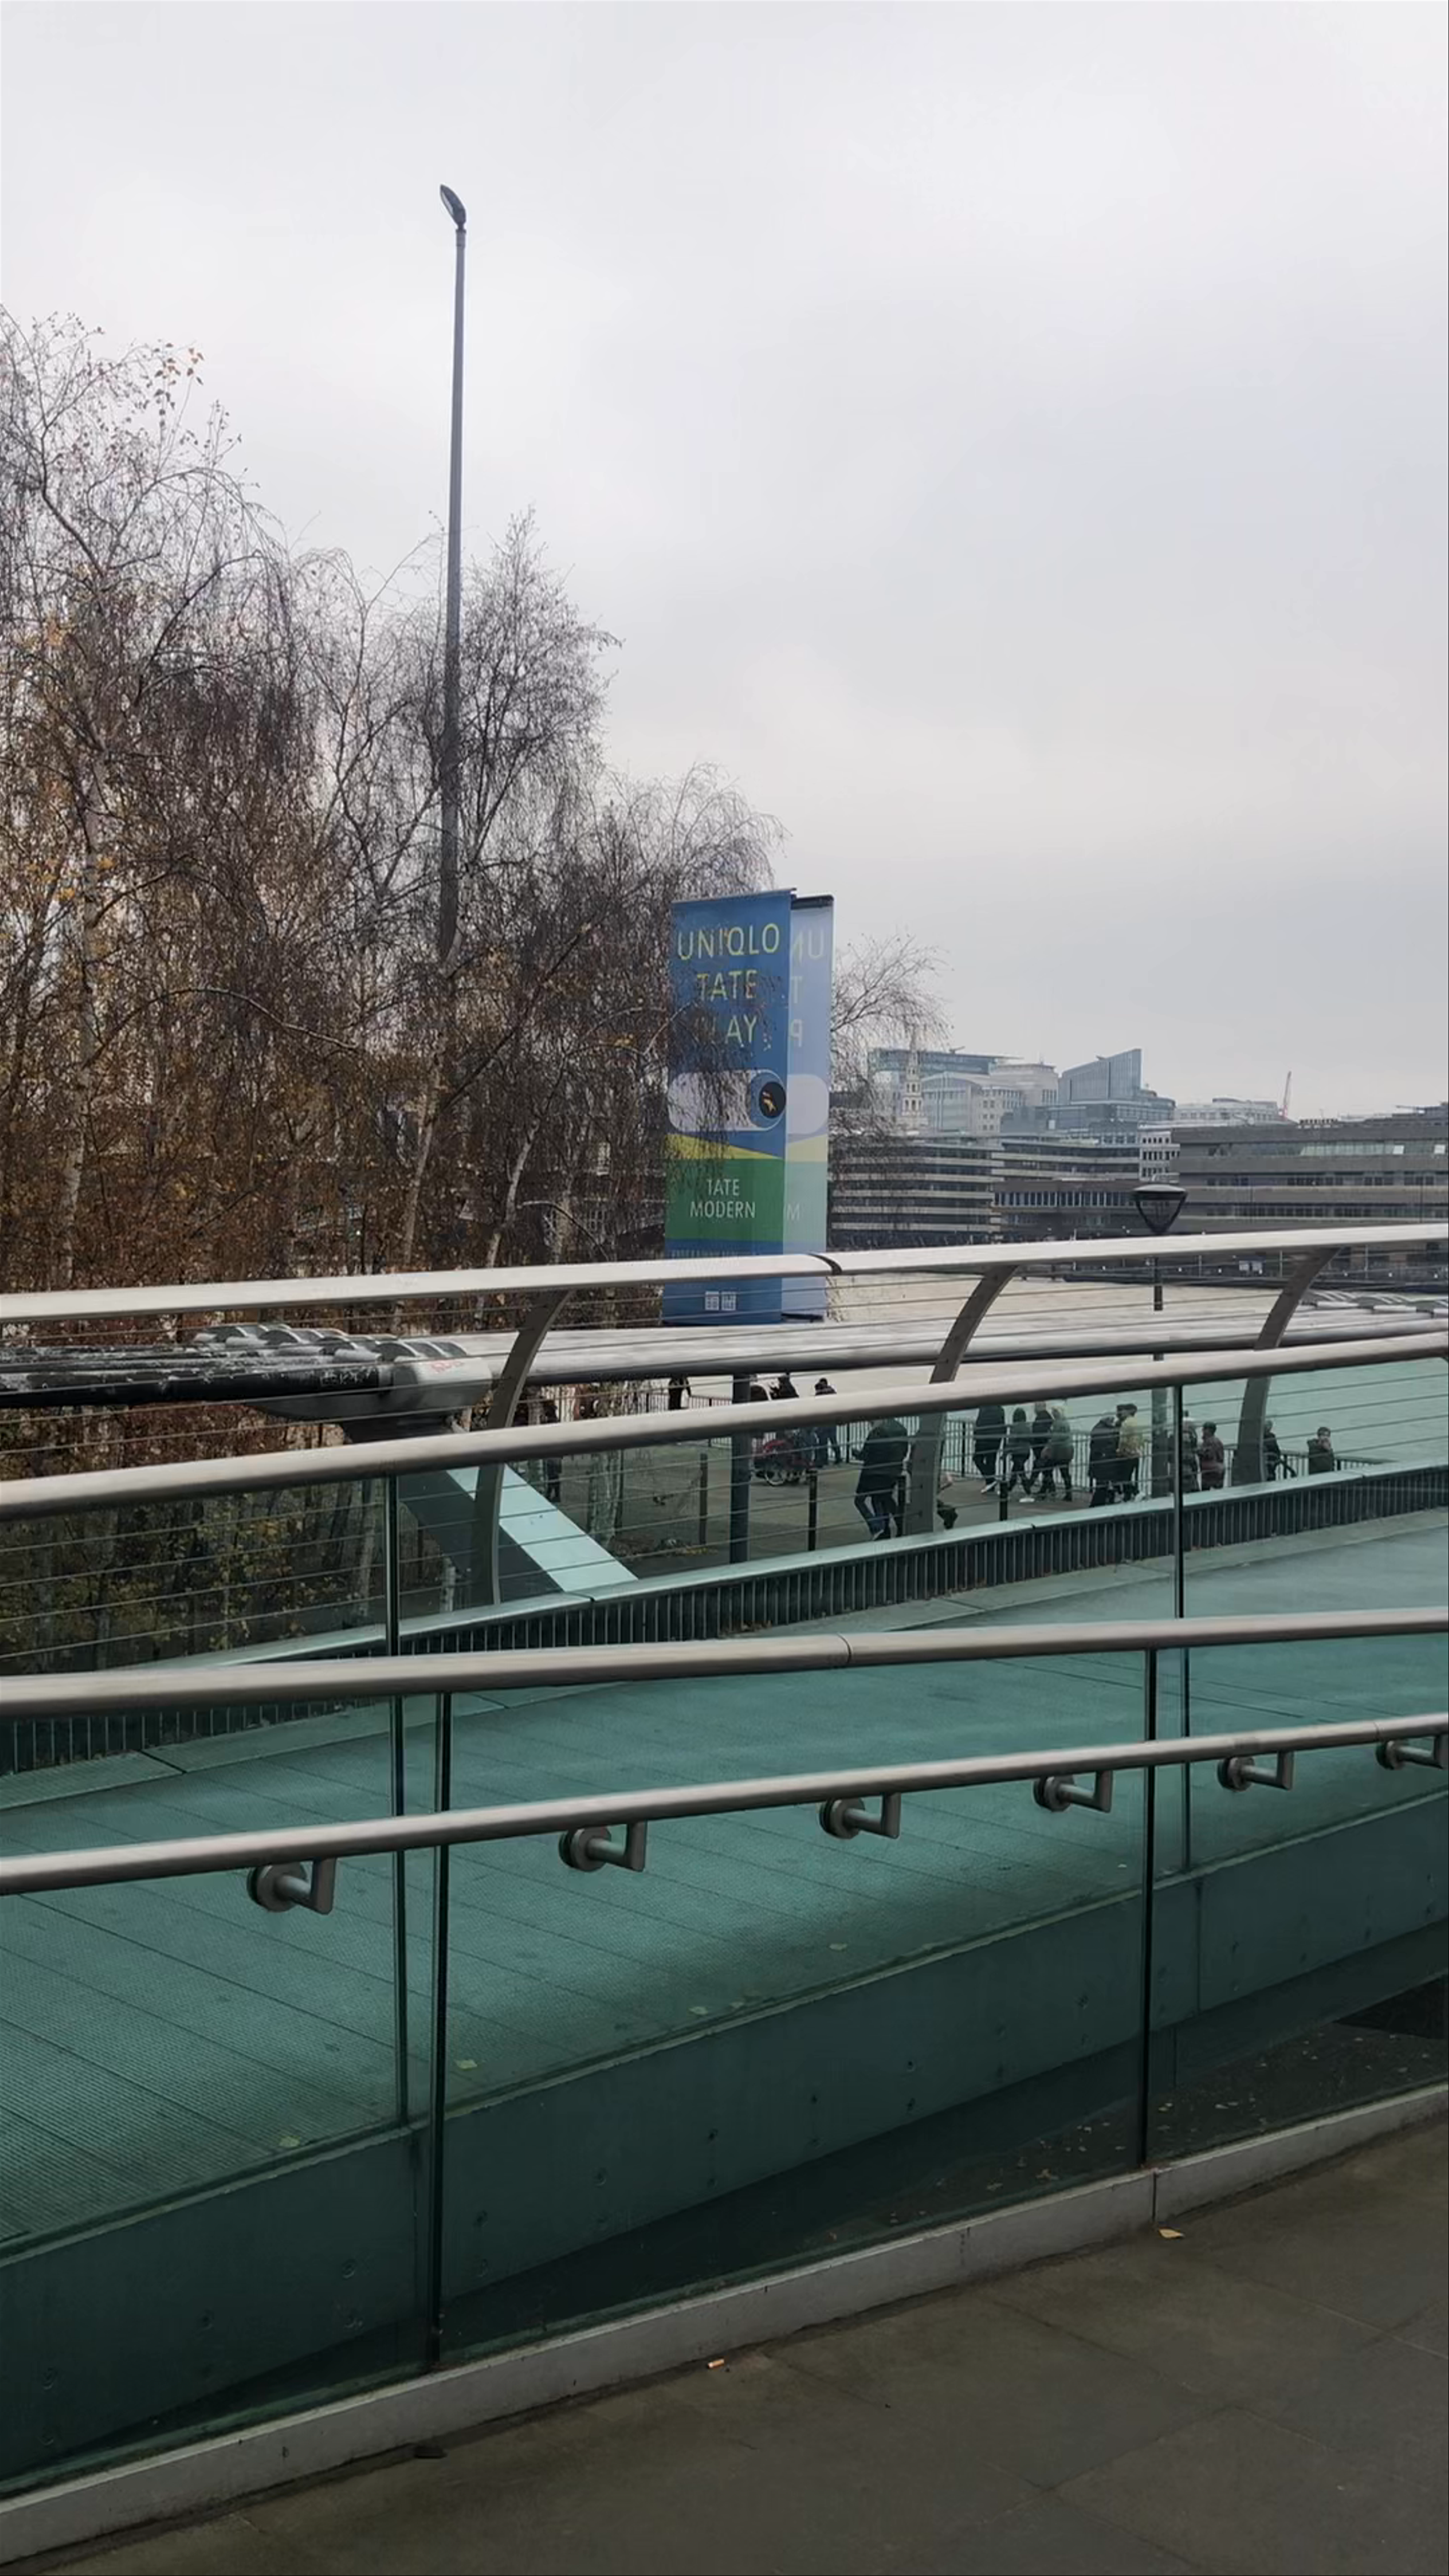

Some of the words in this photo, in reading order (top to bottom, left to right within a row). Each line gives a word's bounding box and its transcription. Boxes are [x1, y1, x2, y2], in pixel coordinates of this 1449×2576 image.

[678, 923, 780, 960] UNIQLO
[697, 969, 757, 1002] TATE
[706, 1178, 740, 1196] TATE
[690, 1201, 755, 1218] MODERN
